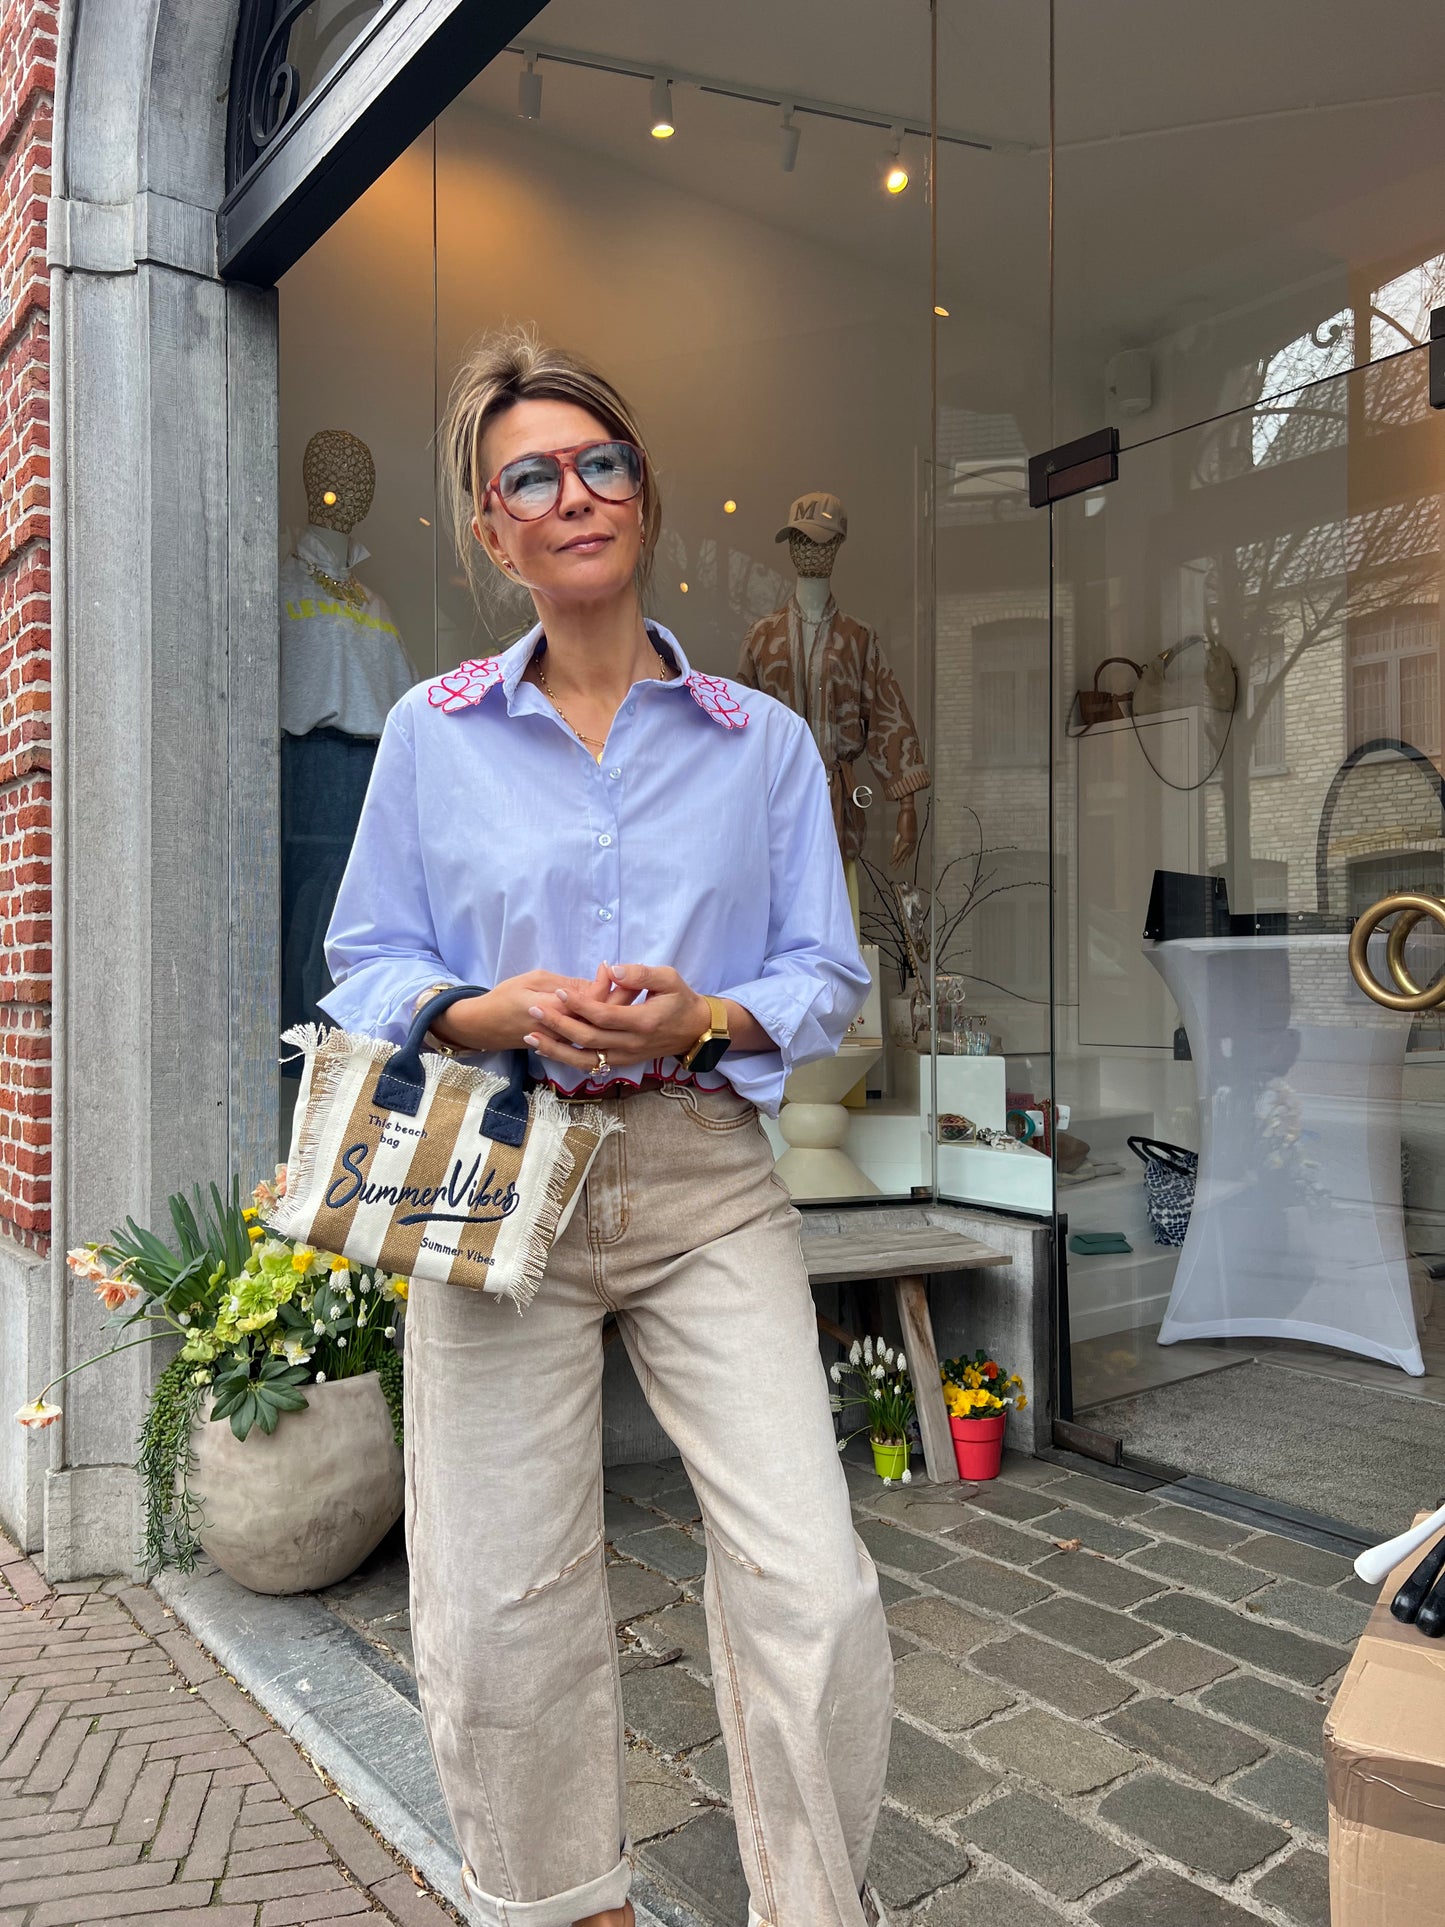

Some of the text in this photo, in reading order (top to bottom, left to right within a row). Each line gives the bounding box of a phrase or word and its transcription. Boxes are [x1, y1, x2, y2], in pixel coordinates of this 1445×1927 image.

[793, 500, 819, 522] M
[367, 1114, 428, 1139] This beach
[379, 1134, 401, 1149] bag
[420, 1236, 496, 1267] Summer Vibes
